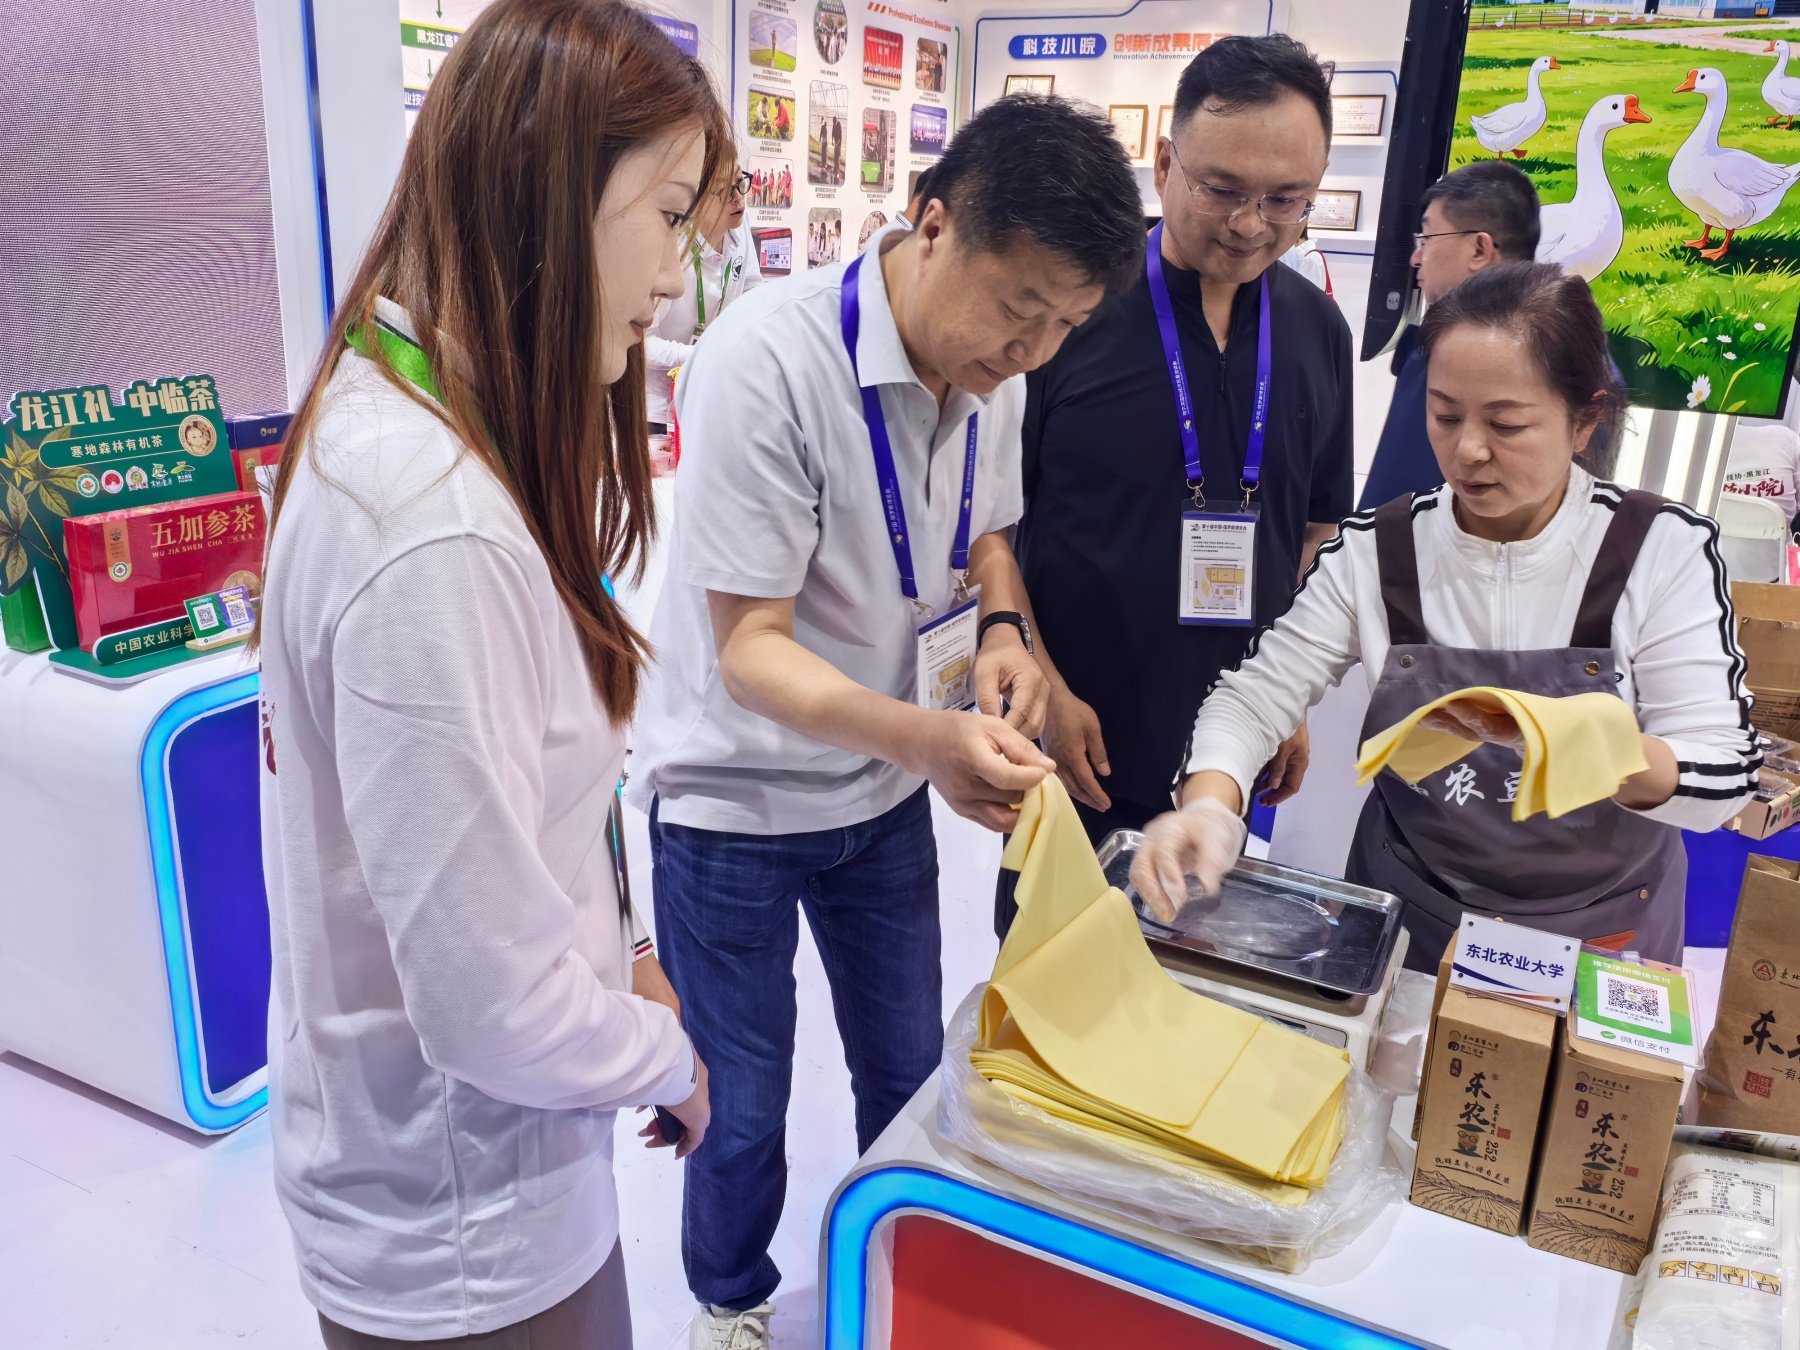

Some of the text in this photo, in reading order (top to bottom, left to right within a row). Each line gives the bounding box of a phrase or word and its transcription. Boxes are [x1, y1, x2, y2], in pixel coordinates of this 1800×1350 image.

[1023, 37, 1096, 56] 科技小院
[16, 379, 216, 432] 龙江礼 中临茶
[70, 434, 163, 458] 寒地森林有机茶
[150, 503, 256, 548] 五加参茶
[182, 543, 203, 552] SHEN
[207, 540, 223, 548] CHA
[1465, 943, 1565, 979] 东北农业大学
[1592, 959, 1671, 985] 推荐使用微信支付
[1620, 1034, 1671, 1055] 微信支付
[1483, 1140, 1499, 1162] 252
[1609, 1177, 1626, 1200] 252
